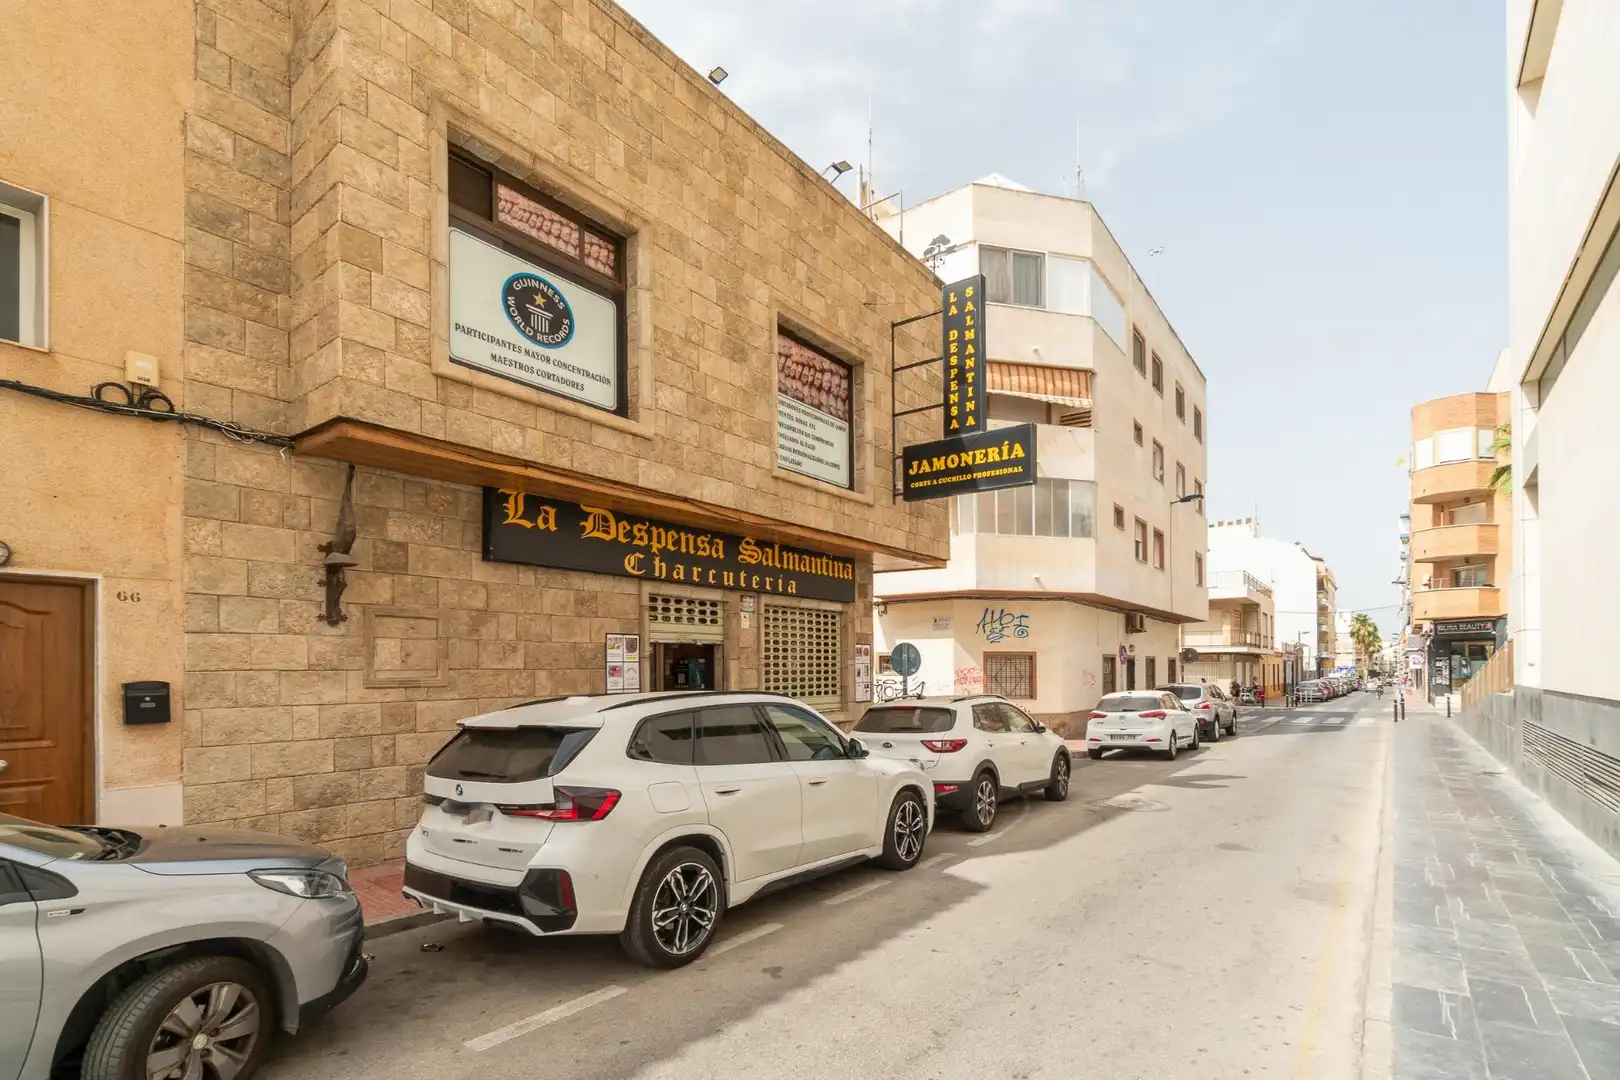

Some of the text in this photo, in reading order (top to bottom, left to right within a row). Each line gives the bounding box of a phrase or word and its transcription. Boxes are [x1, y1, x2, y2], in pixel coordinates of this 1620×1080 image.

[512, 277, 566, 310] GUINNESS
[507, 296, 571, 344] WORLD RECORDS
[454, 322, 612, 386] PARTICIPANTES MAYOR CONCENTRACIÓN
[490, 352, 585, 392] MAESTROS CORTADORES
[948, 291, 960, 430] LA DESPENSA
[964, 287, 976, 426] SALMANTINA
[908, 440, 1026, 476] JAMONERÍA
[910, 465, 1024, 489] CORTE A CUCHILLO PROFESIONAL
[498, 487, 854, 581] La Despensa Salmantina
[624, 551, 797, 594] Charcuteria
[116, 590, 141, 603] 66
